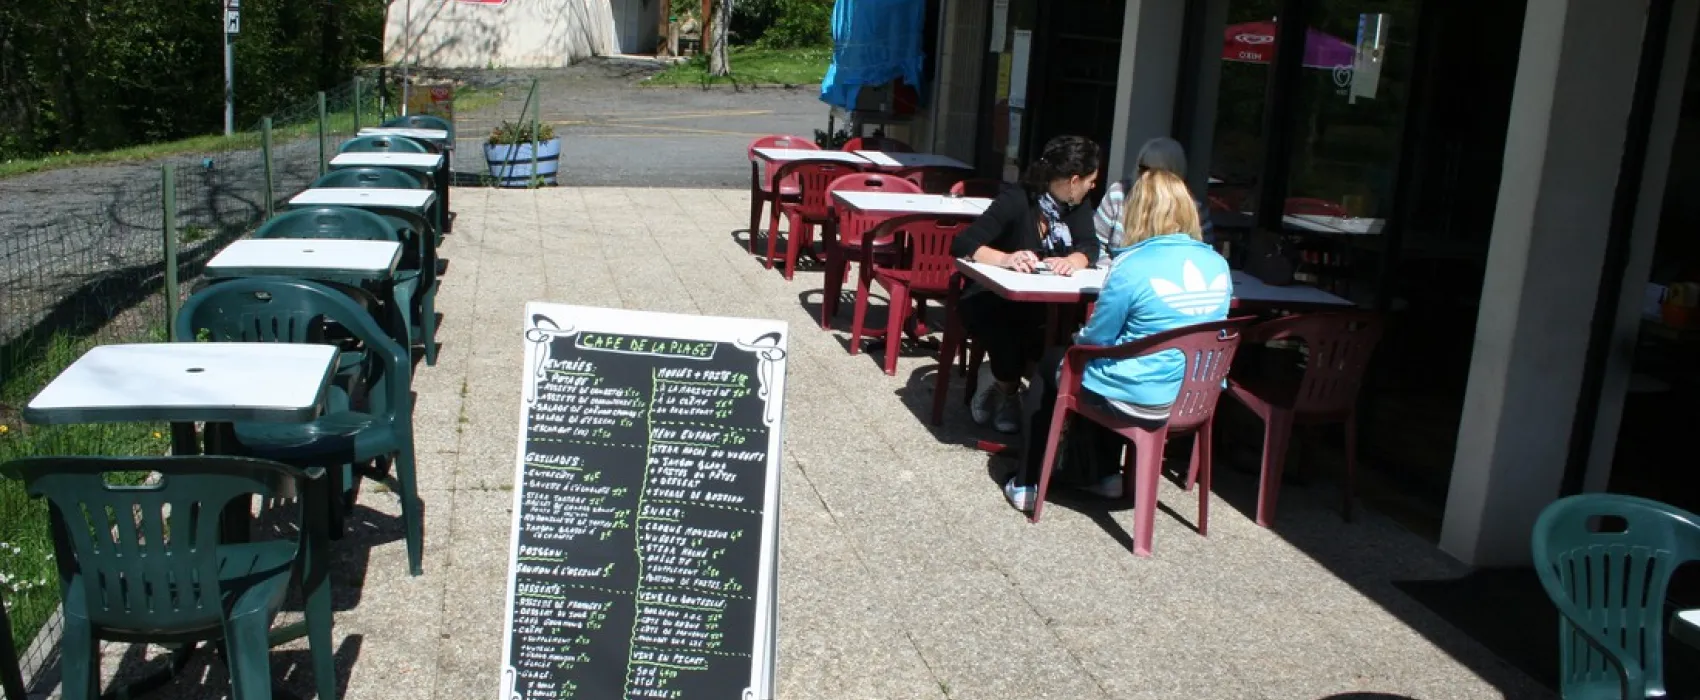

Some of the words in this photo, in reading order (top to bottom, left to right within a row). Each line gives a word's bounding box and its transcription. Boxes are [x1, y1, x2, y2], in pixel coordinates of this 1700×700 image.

[631, 338, 649, 350] DE
[651, 341, 666, 352] LA
[669, 340, 714, 355] PLAGE
